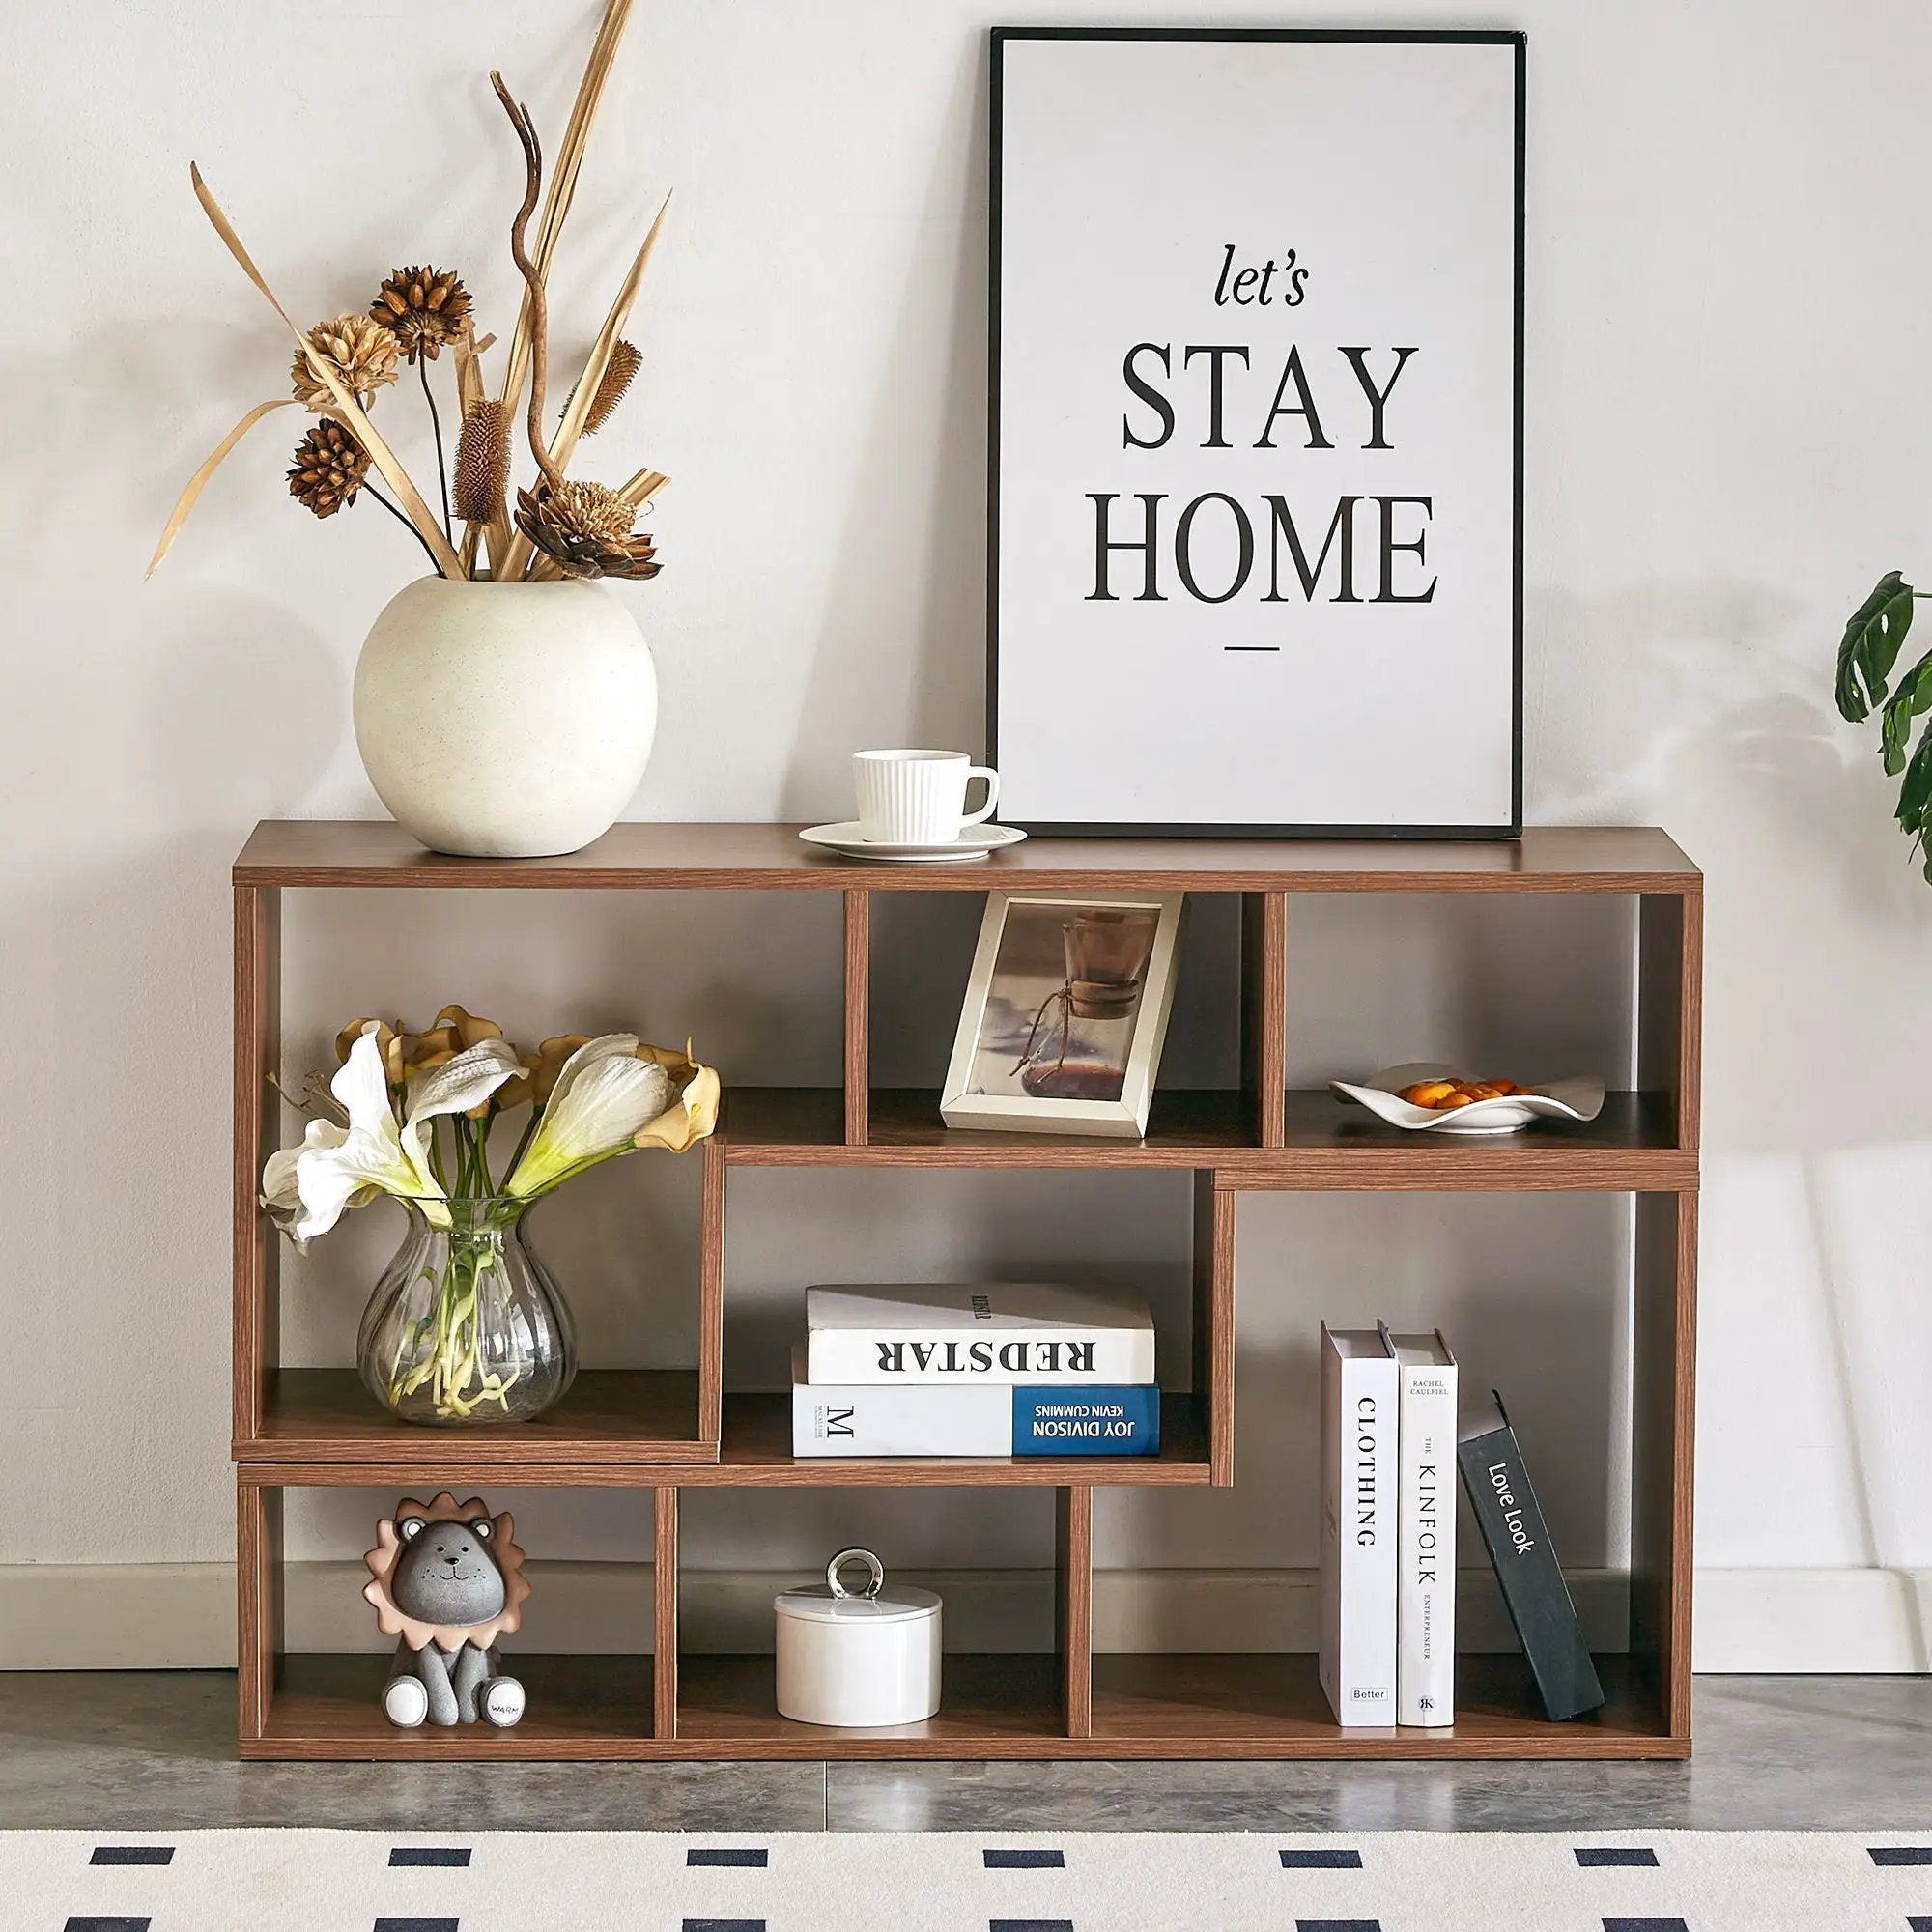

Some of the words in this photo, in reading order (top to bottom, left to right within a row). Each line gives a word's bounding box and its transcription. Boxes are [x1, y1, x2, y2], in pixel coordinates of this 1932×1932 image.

[1214, 243, 1309, 307] let's
[1122, 342, 1420, 450] STAY
[1084, 492, 1438, 604] HOME
[874, 1341, 1096, 1373] REDSTAR
[826, 1406, 855, 1438] M
[1035, 1406, 1090, 1417] CUMMINS
[1092, 1406, 1123, 1417] KEVIN
[1033, 1421, 1100, 1437] DIVISON
[1104, 1421, 1136, 1437] JOY
[1357, 1397, 1376, 1547] CLOTHING
[1418, 1465, 1436, 1585] KINFOLK
[1488, 1463, 1515, 1508] Love
[1504, 1509, 1535, 1556] Look
[491, 1705, 519, 1715] WARM
[1353, 1690, 1384, 1699] Better
